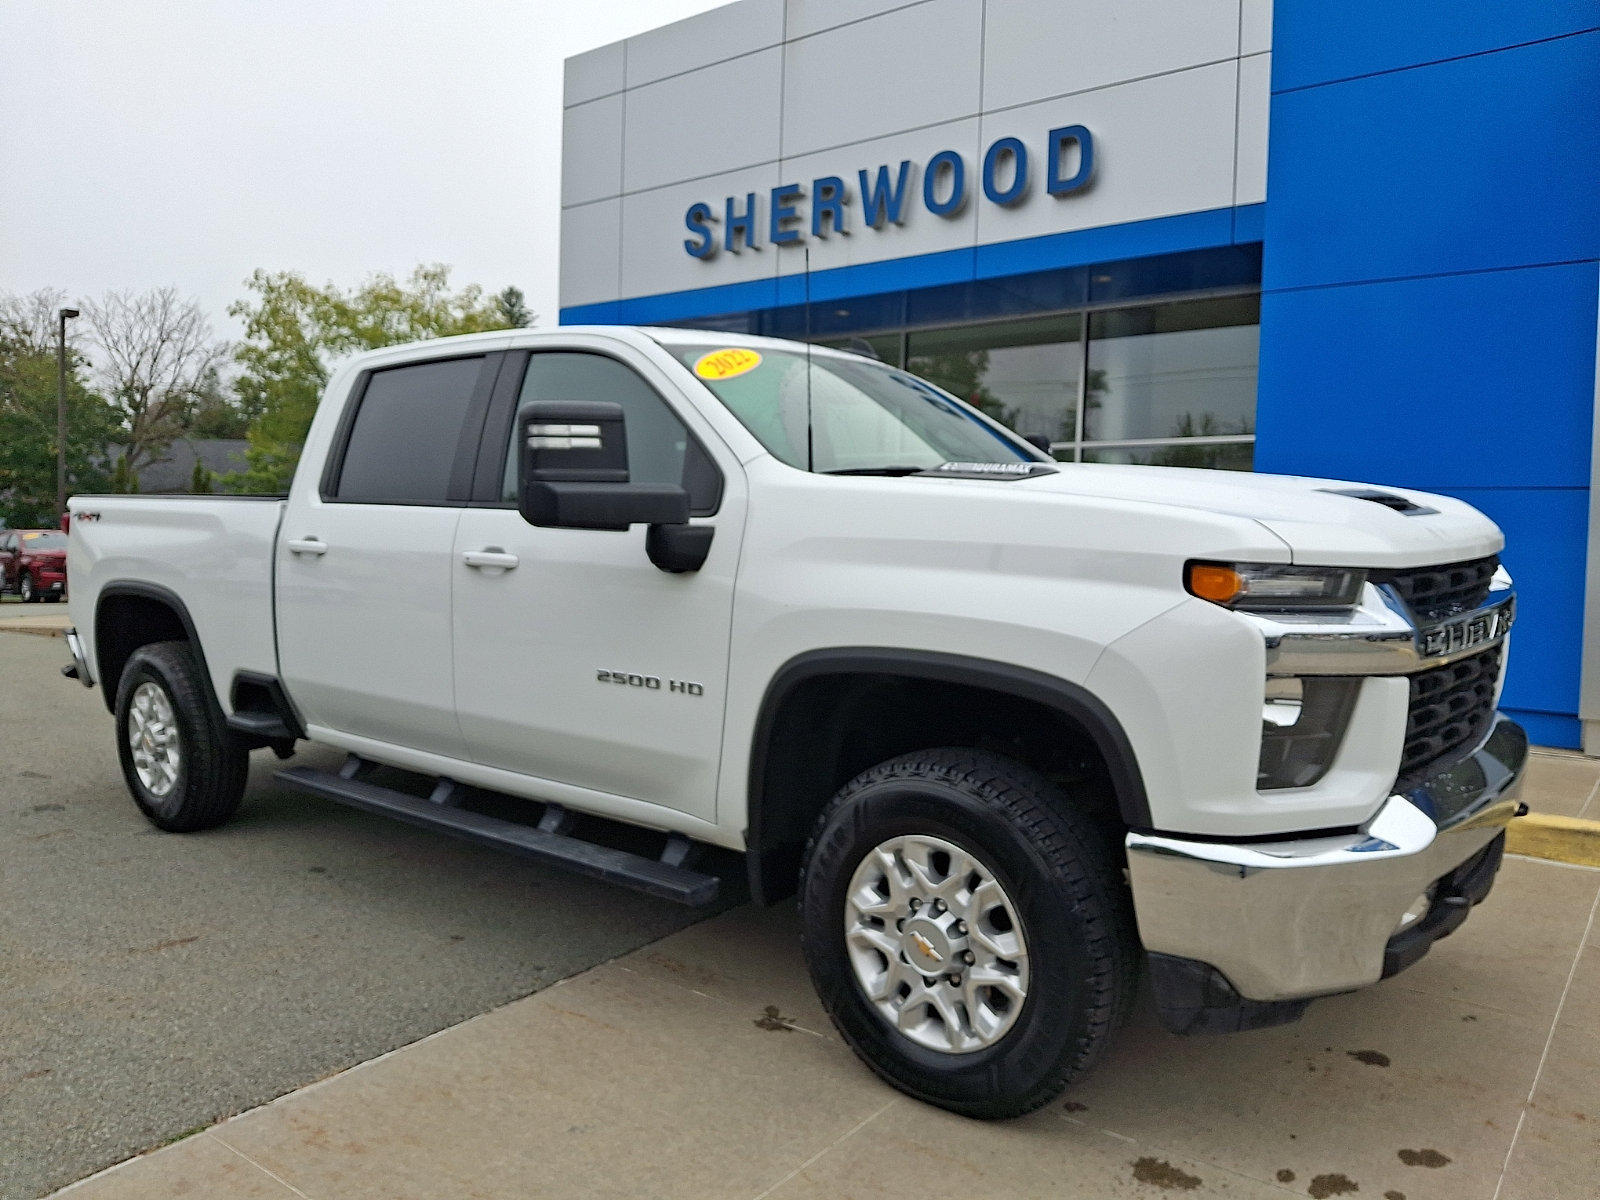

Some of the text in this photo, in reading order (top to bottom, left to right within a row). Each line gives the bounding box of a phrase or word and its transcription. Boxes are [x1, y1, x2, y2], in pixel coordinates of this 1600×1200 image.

[684, 124, 1095, 259] SHERWOOD
[597, 668, 704, 697] 2500 HD
